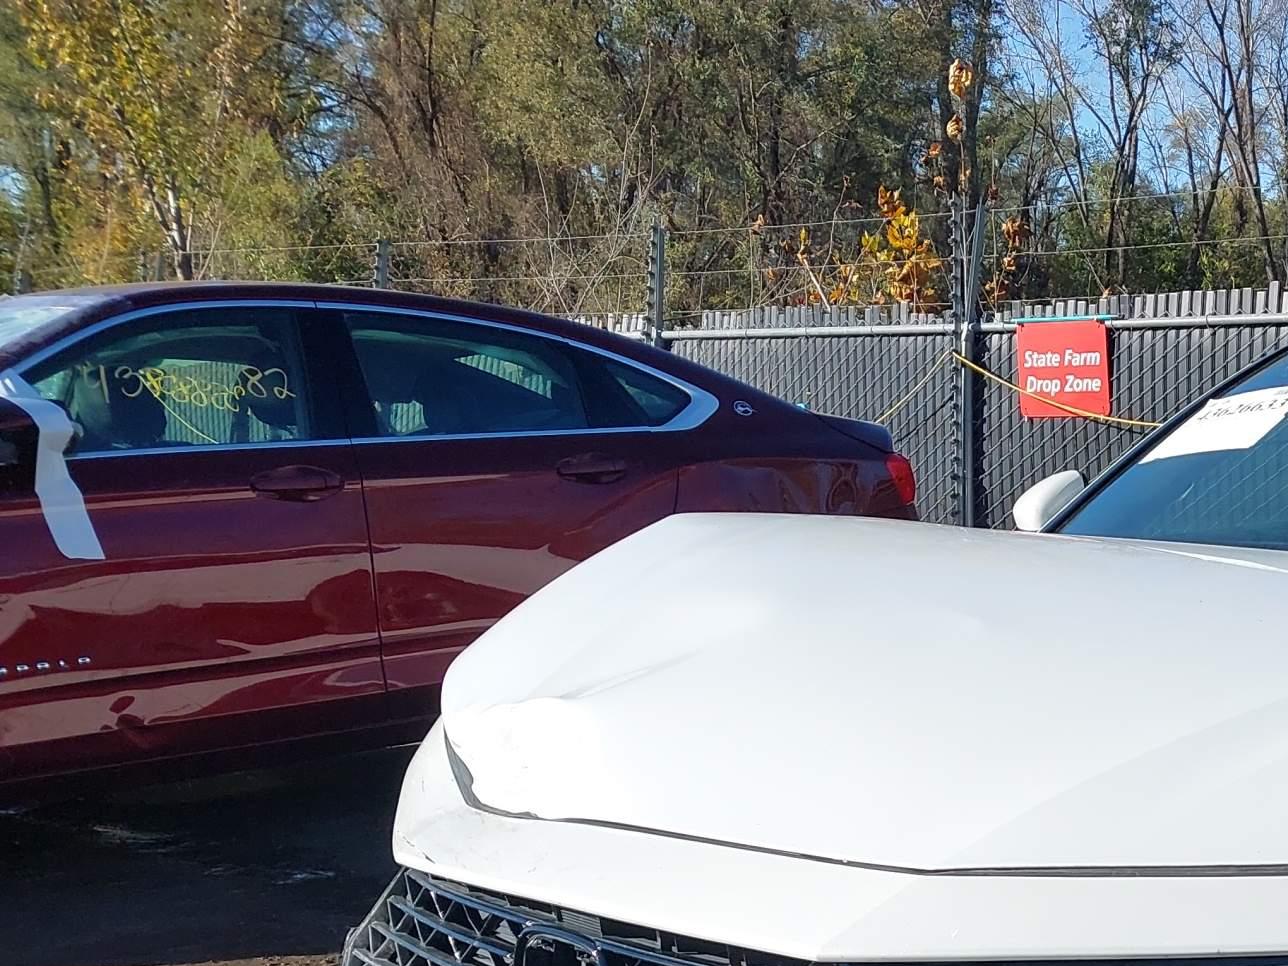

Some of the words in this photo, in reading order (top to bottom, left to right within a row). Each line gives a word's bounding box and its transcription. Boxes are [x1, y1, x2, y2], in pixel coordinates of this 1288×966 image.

[1024, 350, 1060, 368] State
[1063, 348, 1100, 366] Farm
[1026, 375, 1061, 397] Drop
[1063, 374, 1102, 393] Zone
